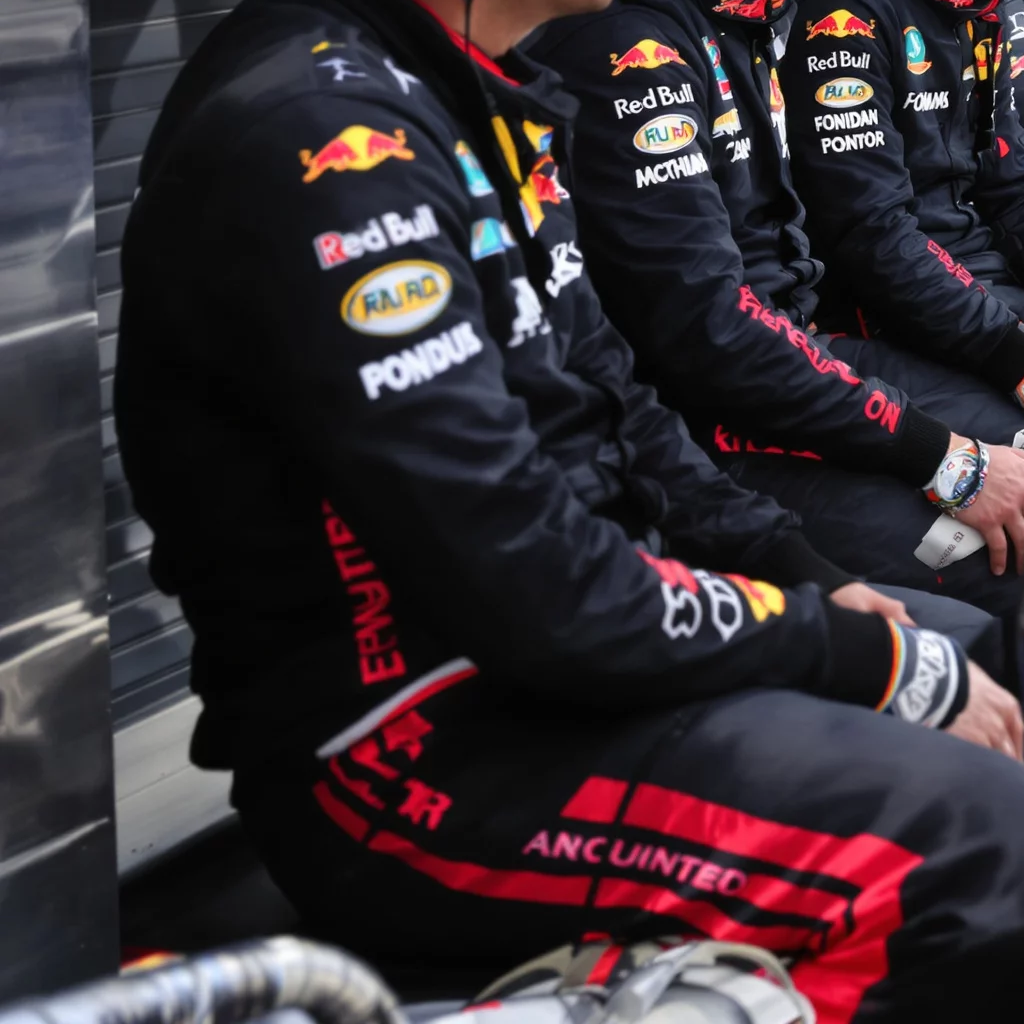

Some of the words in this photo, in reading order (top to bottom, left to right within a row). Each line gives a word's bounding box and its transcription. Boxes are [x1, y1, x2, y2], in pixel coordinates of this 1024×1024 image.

[807, 50, 838, 73] Red
[839, 50, 871, 69] Bull
[613, 87, 658, 119] Red
[656, 83, 695, 106] Bull
[820, 130, 886, 154] PONTOR
[312, 217, 389, 271] Red
[381, 203, 440, 246] Bull
